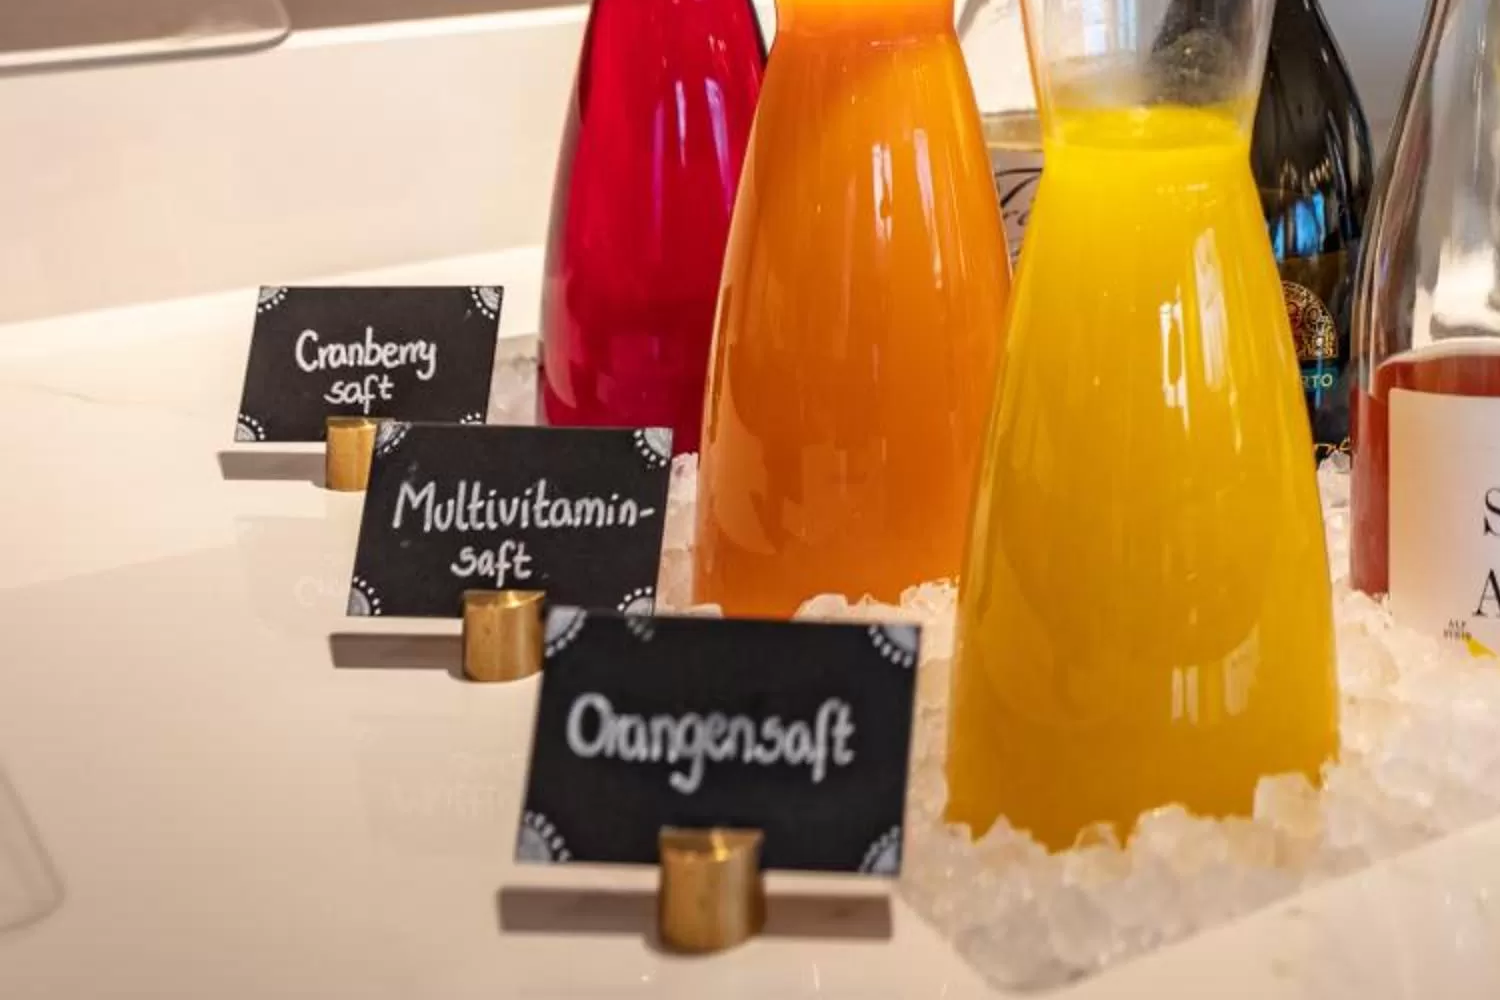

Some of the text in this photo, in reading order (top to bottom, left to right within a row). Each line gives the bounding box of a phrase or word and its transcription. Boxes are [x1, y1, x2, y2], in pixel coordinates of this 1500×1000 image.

[295, 325, 437, 380] Cranberry
[323, 373, 395, 415] saft
[392, 479, 655, 532] Multivitamin-
[450, 541, 532, 587] saft
[566, 693, 855, 793] Orangensaft
